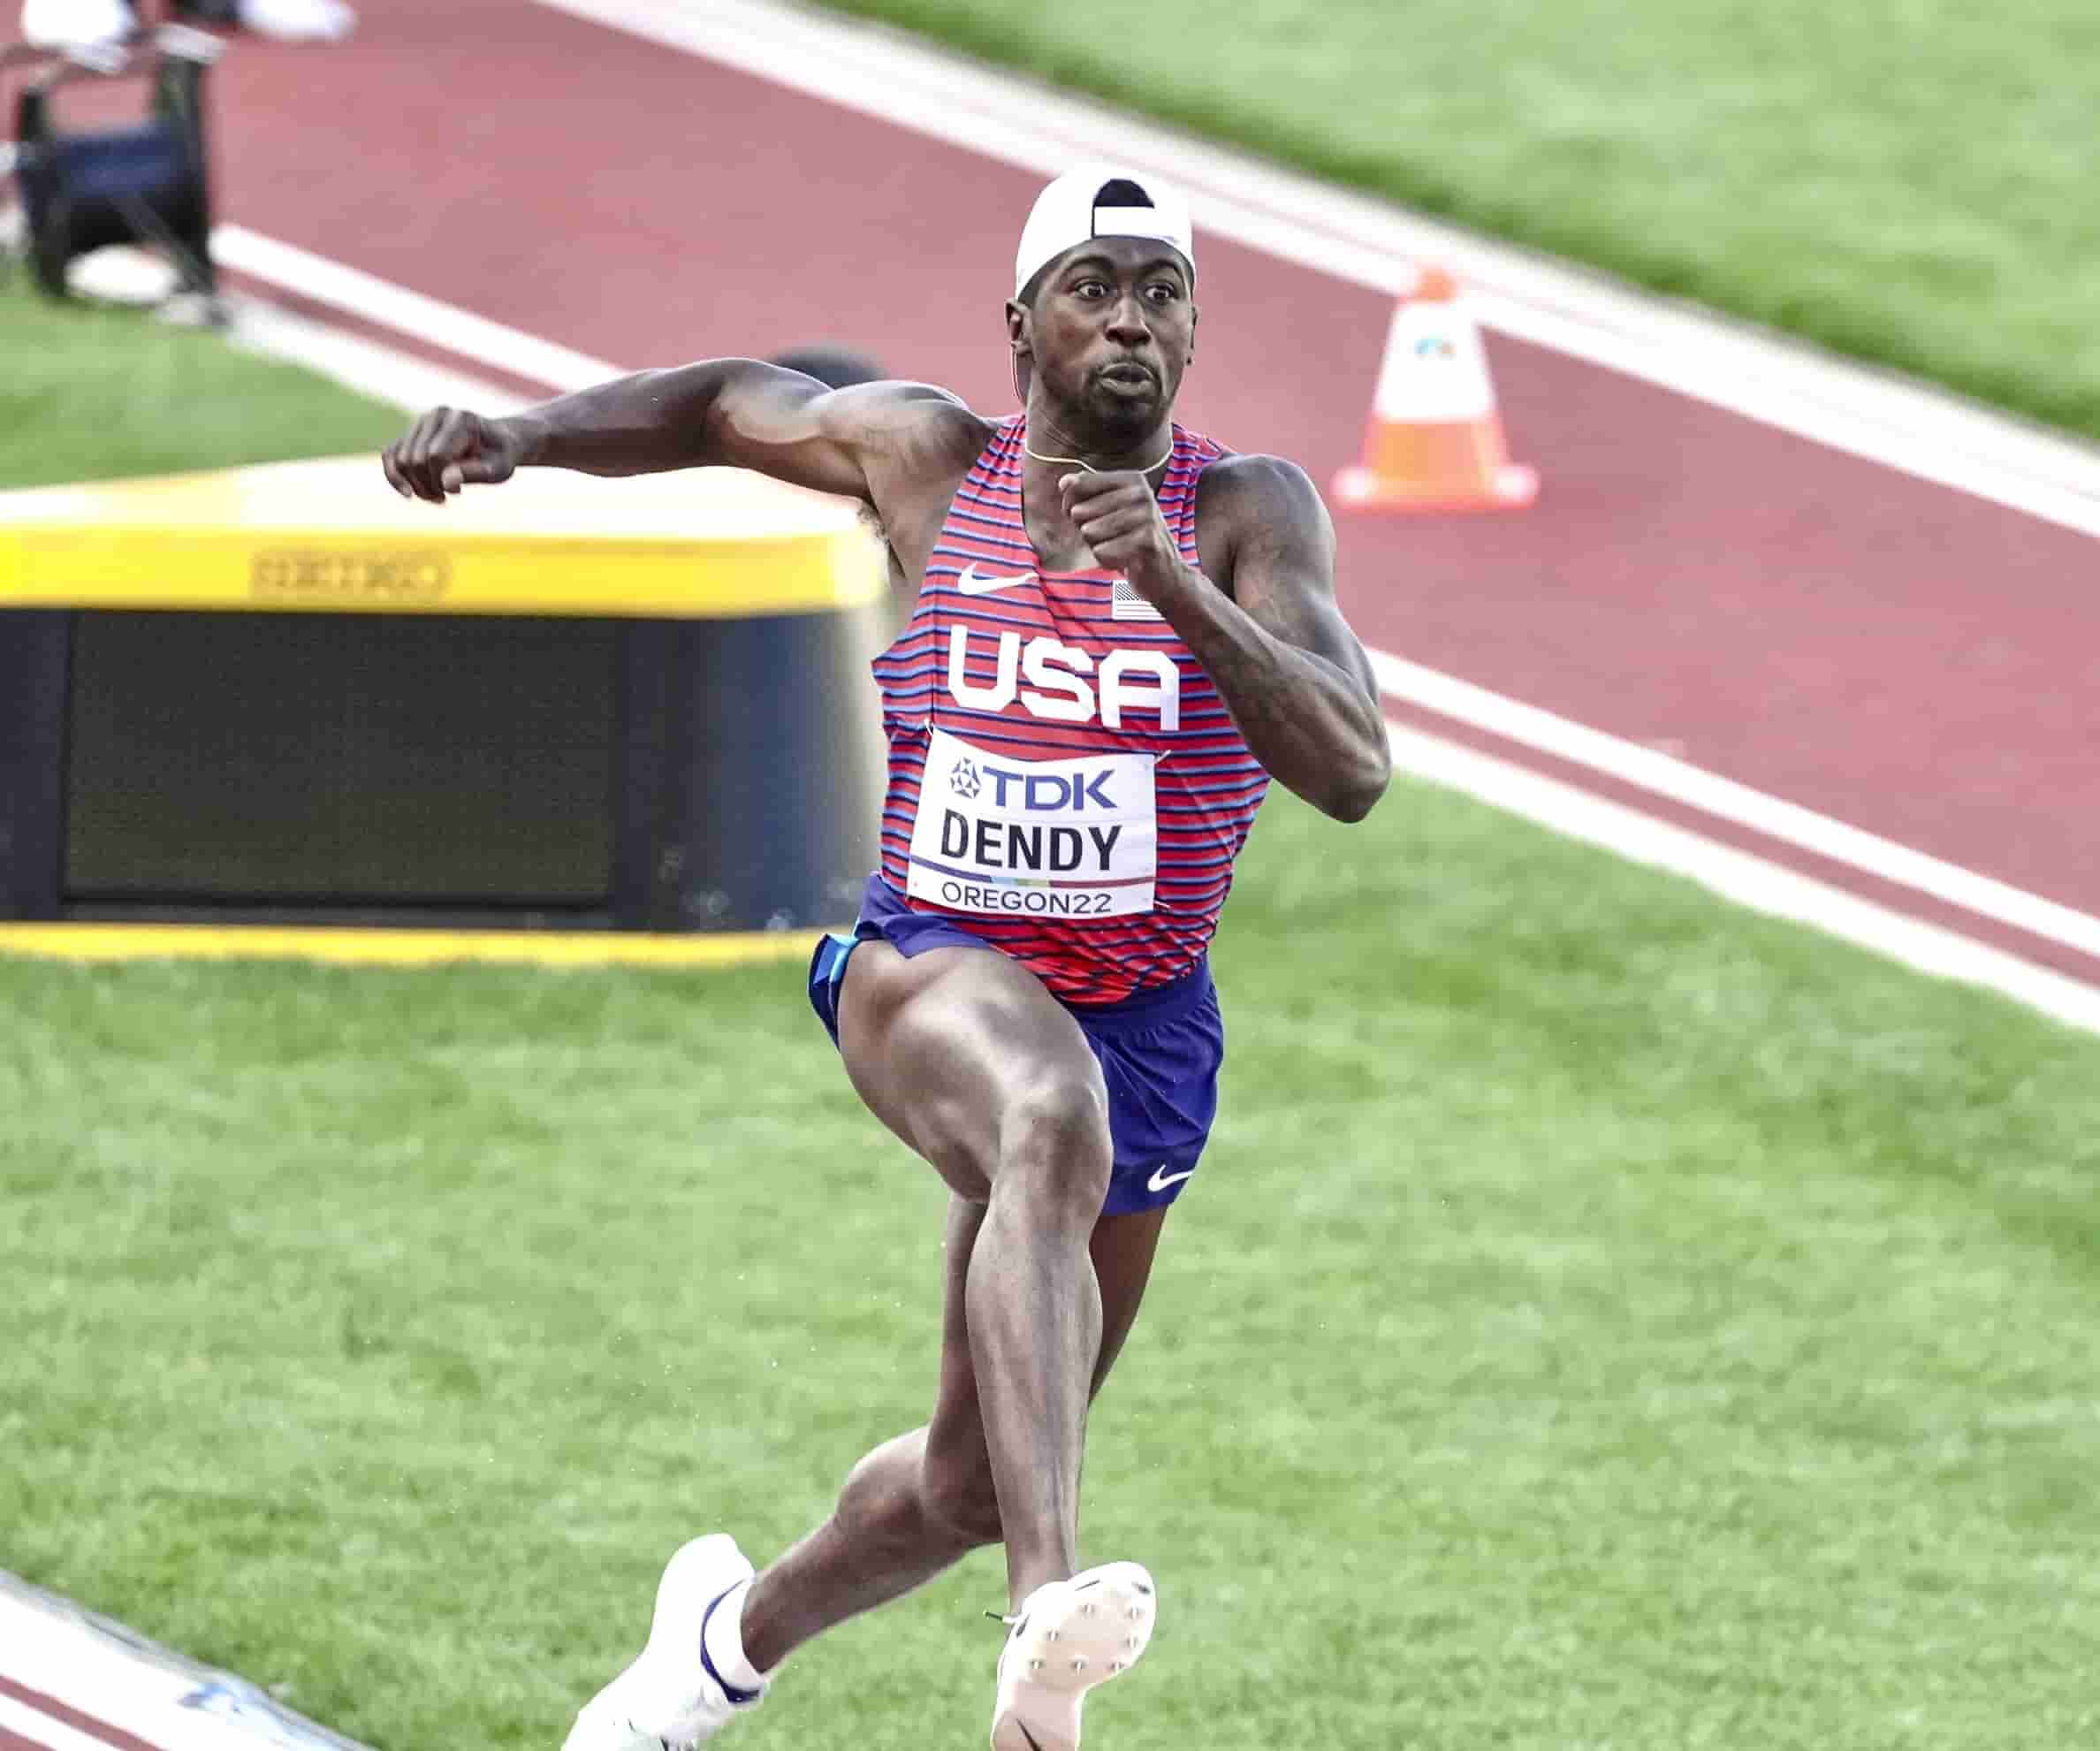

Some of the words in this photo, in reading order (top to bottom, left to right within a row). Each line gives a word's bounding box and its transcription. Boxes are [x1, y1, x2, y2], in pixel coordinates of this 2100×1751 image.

[948, 624, 1179, 731] USA
[982, 766, 1117, 811] TDK
[940, 809, 1122, 872] DENDY
[941, 881, 1113, 914] OREGON22
